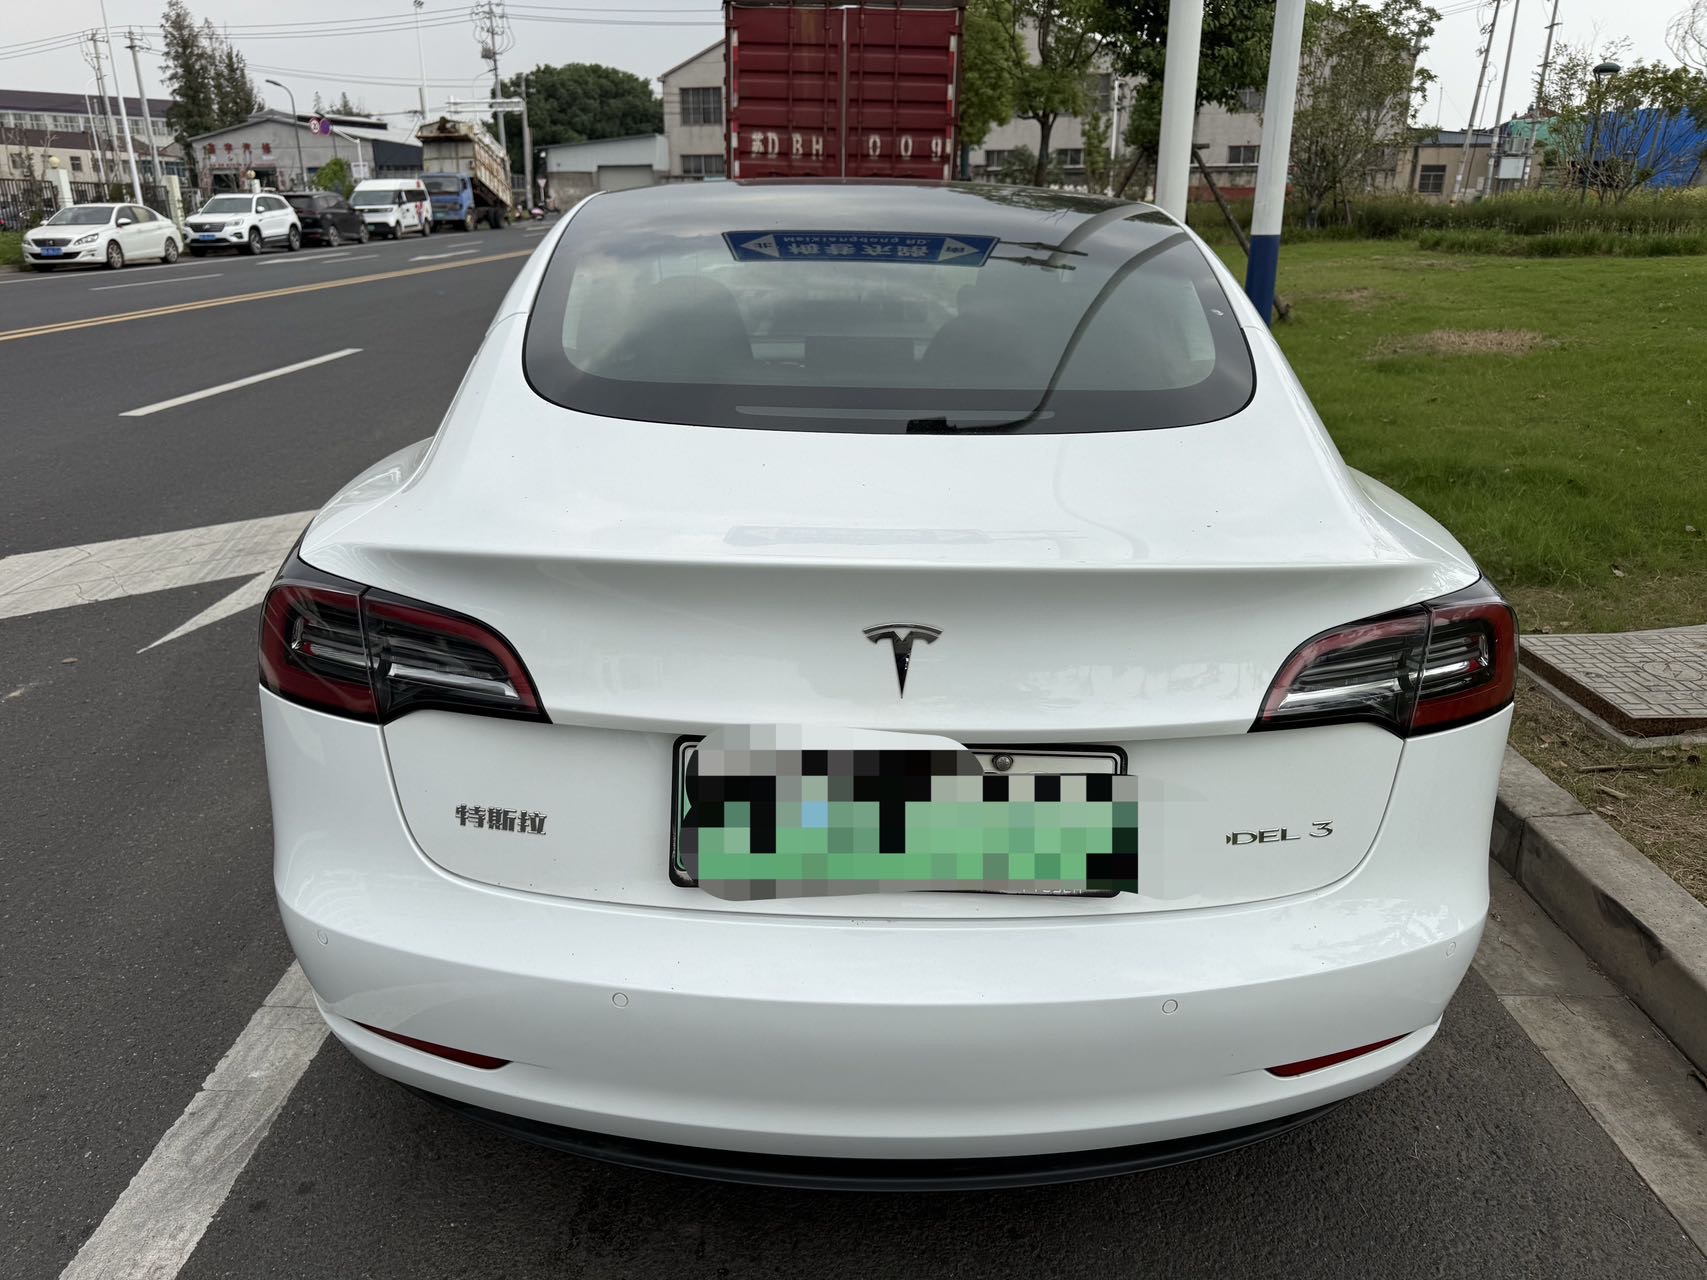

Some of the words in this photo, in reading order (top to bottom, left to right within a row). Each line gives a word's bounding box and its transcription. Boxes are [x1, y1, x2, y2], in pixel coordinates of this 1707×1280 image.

[455, 803, 548, 836] 特斯拉
[1226, 826, 1302, 845] DEL
[1309, 819, 1334, 838] 3
